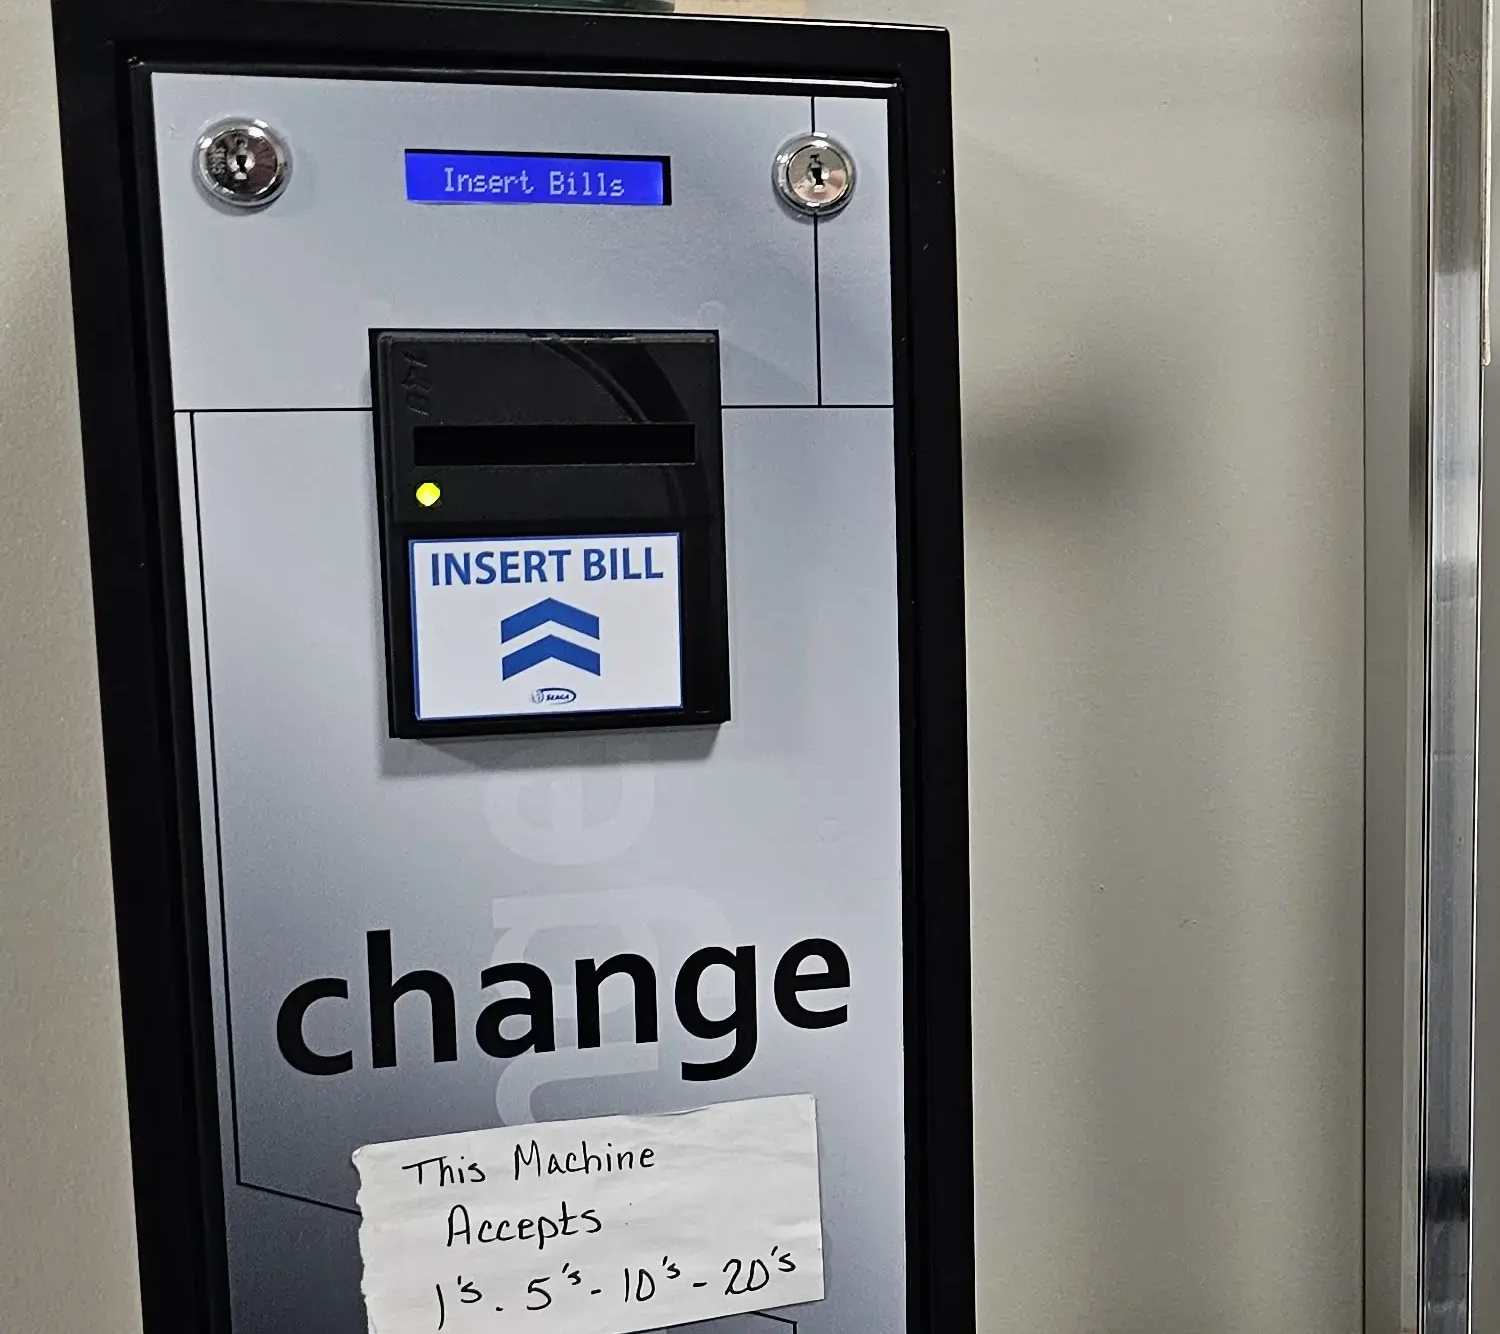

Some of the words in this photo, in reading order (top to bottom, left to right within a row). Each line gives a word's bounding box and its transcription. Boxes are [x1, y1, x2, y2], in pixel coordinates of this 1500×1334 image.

[444, 167, 534, 194] Insert
[549, 170, 625, 197] Bills
[431, 549, 572, 586] INSERT
[583, 546, 664, 582] BILL
[546, 692, 571, 701] SEAGA
[275, 929, 851, 1082] change
[402, 1155, 487, 1187] This
[514, 1139, 656, 1181] Machine
[446, 1200, 602, 1250] Accepts
[436, 1274, 483, 1331] 1's
[526, 1262, 582, 1311] 5's
[624, 1255, 681, 1303] 10's
[723, 1245, 797, 1296] 20's
